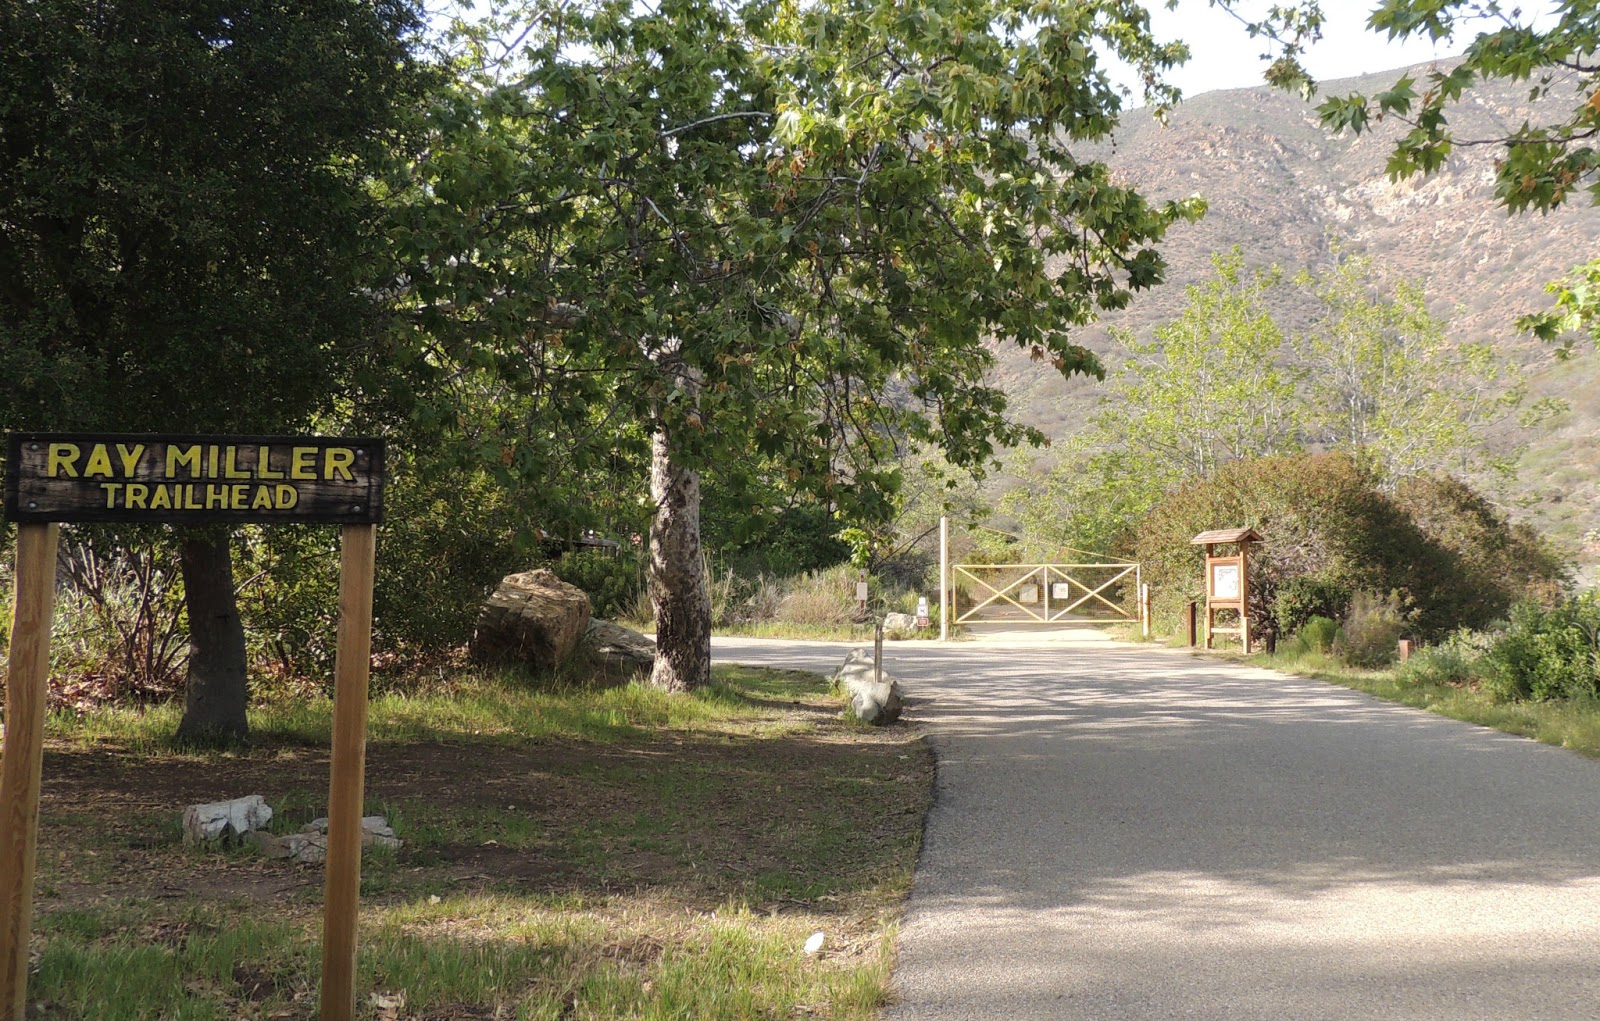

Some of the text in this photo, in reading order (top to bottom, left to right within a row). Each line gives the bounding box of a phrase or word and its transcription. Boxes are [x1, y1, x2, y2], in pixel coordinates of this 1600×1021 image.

[47, 443, 357, 481] RAY MILLER
[100, 482, 299, 510] TRAILHEAD
